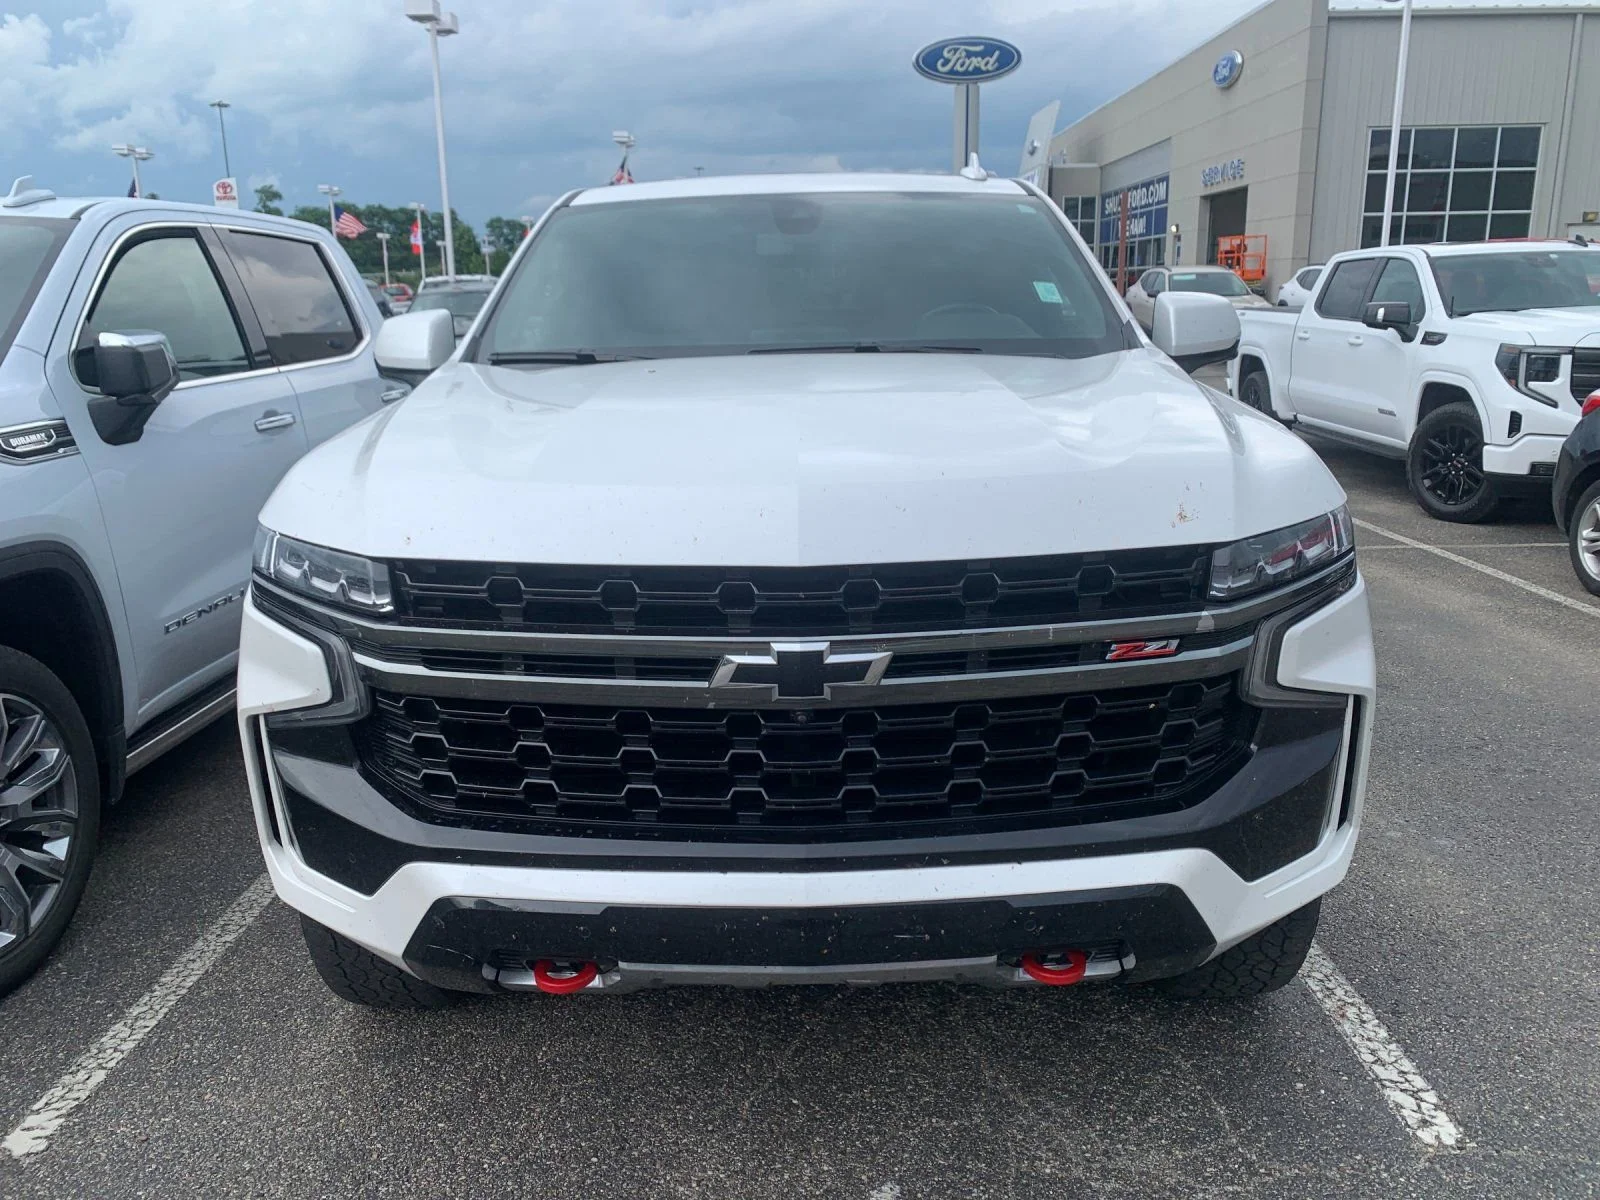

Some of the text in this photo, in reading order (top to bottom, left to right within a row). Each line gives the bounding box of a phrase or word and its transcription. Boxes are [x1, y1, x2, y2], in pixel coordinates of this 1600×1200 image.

[936, 45, 1000, 73] Ford
[1200, 159, 1245, 186] SERVICE
[9, 432, 48, 447] DURAMAX
[163, 587, 245, 634] DENALI
[1105, 639, 1181, 660] Z71
